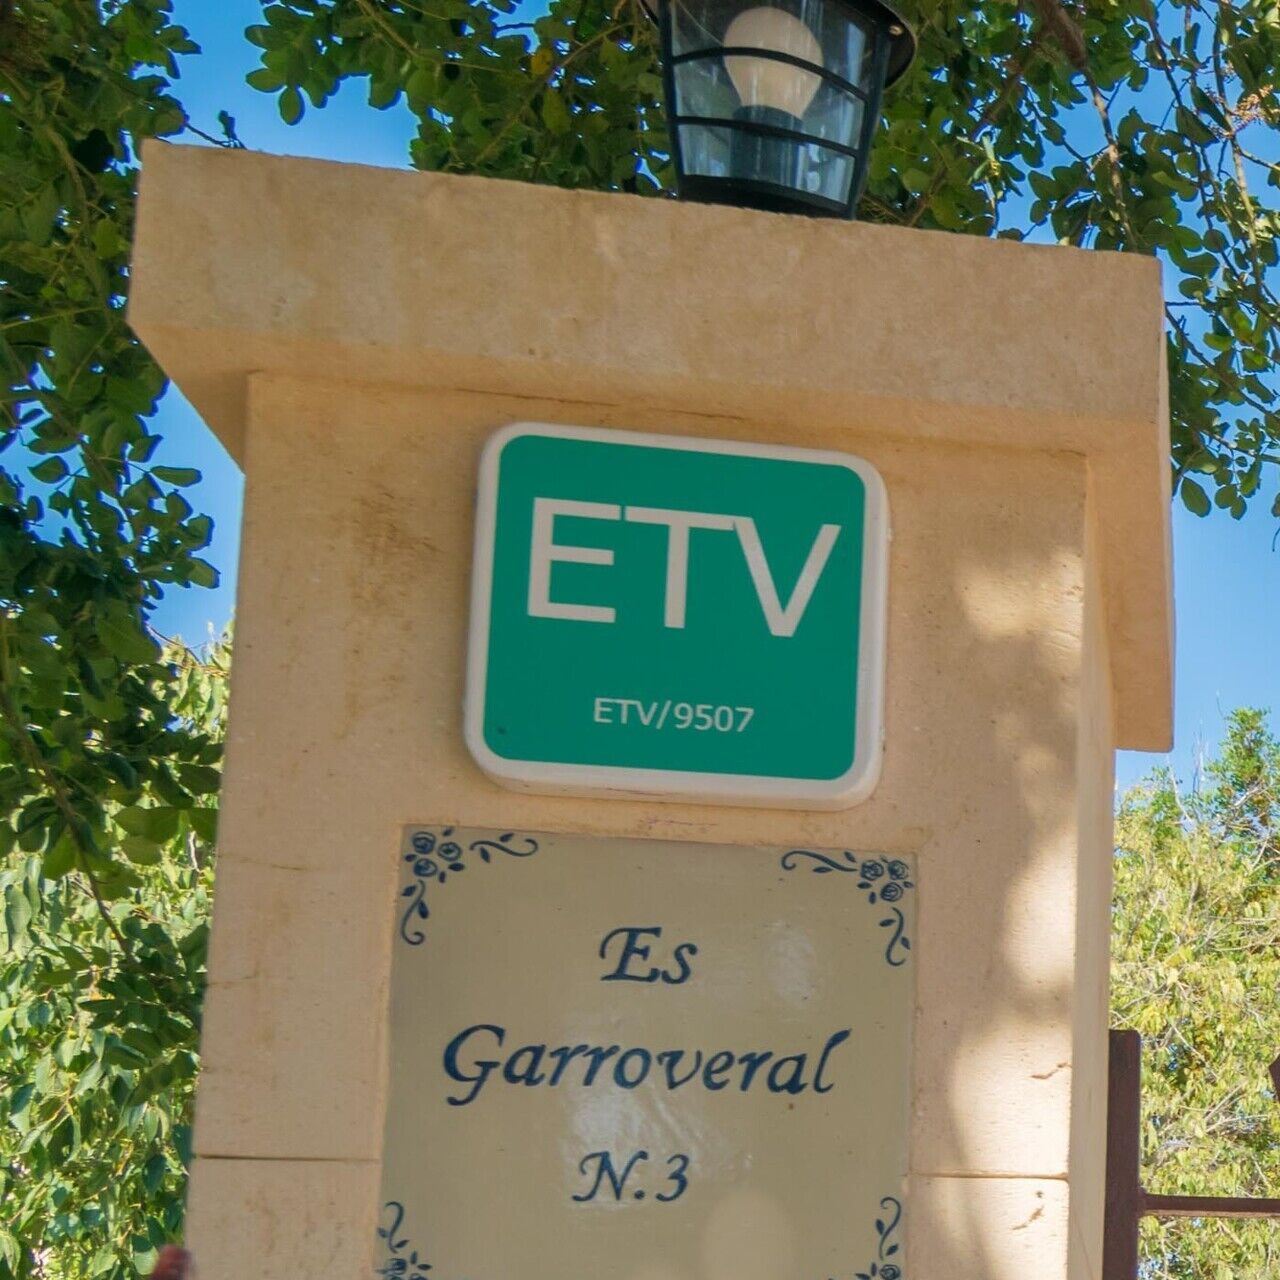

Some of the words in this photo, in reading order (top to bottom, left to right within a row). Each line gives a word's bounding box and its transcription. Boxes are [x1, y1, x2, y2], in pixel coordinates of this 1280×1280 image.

[527, 497, 841, 637] ETV
[593, 697, 754, 733] ETV/9507
[599, 927, 698, 984] Es
[443, 1024, 852, 1106] Garroveral
